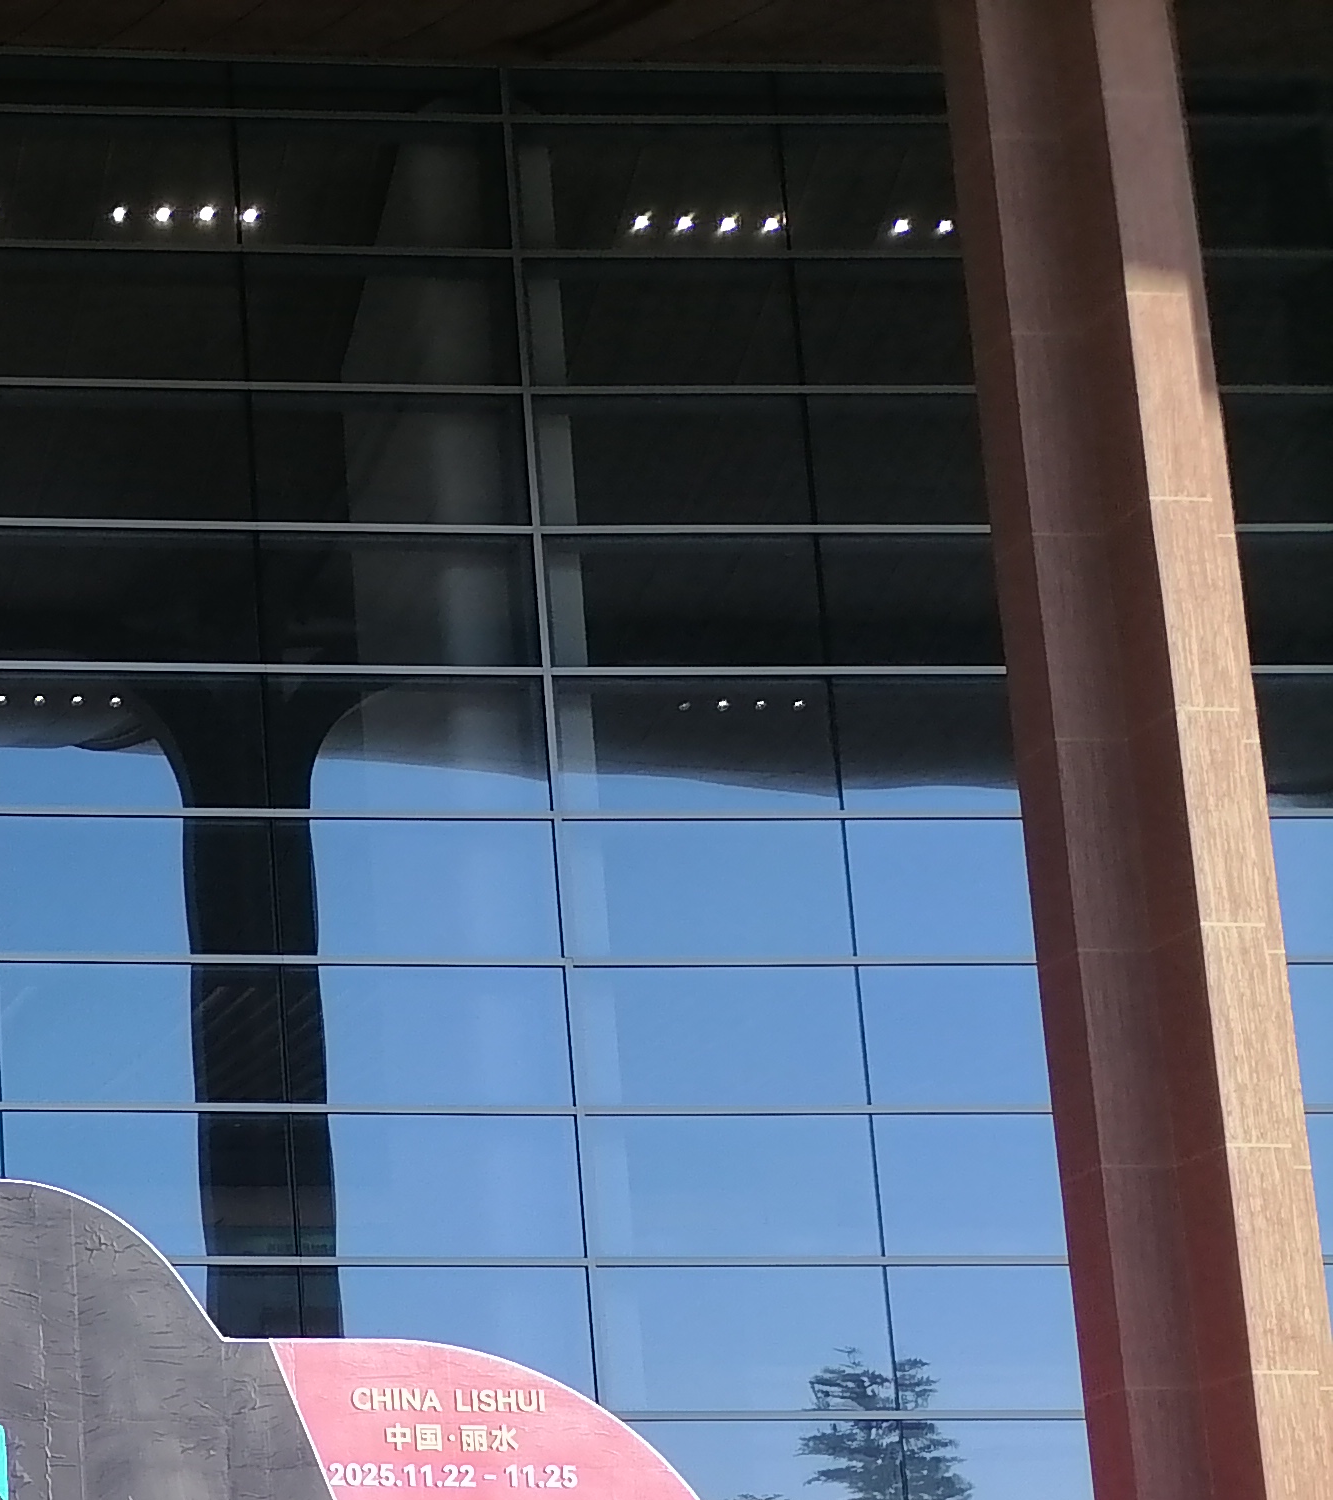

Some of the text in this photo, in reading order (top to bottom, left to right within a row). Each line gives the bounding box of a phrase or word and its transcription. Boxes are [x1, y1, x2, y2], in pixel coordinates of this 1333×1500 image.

[350, 1387, 546, 1412] CHINA LISHUI
[384, 1422, 520, 1452] 中国·丽水
[328, 1462, 477, 1488] 2025.11.22
[504, 1464, 579, 1488] 11.25
